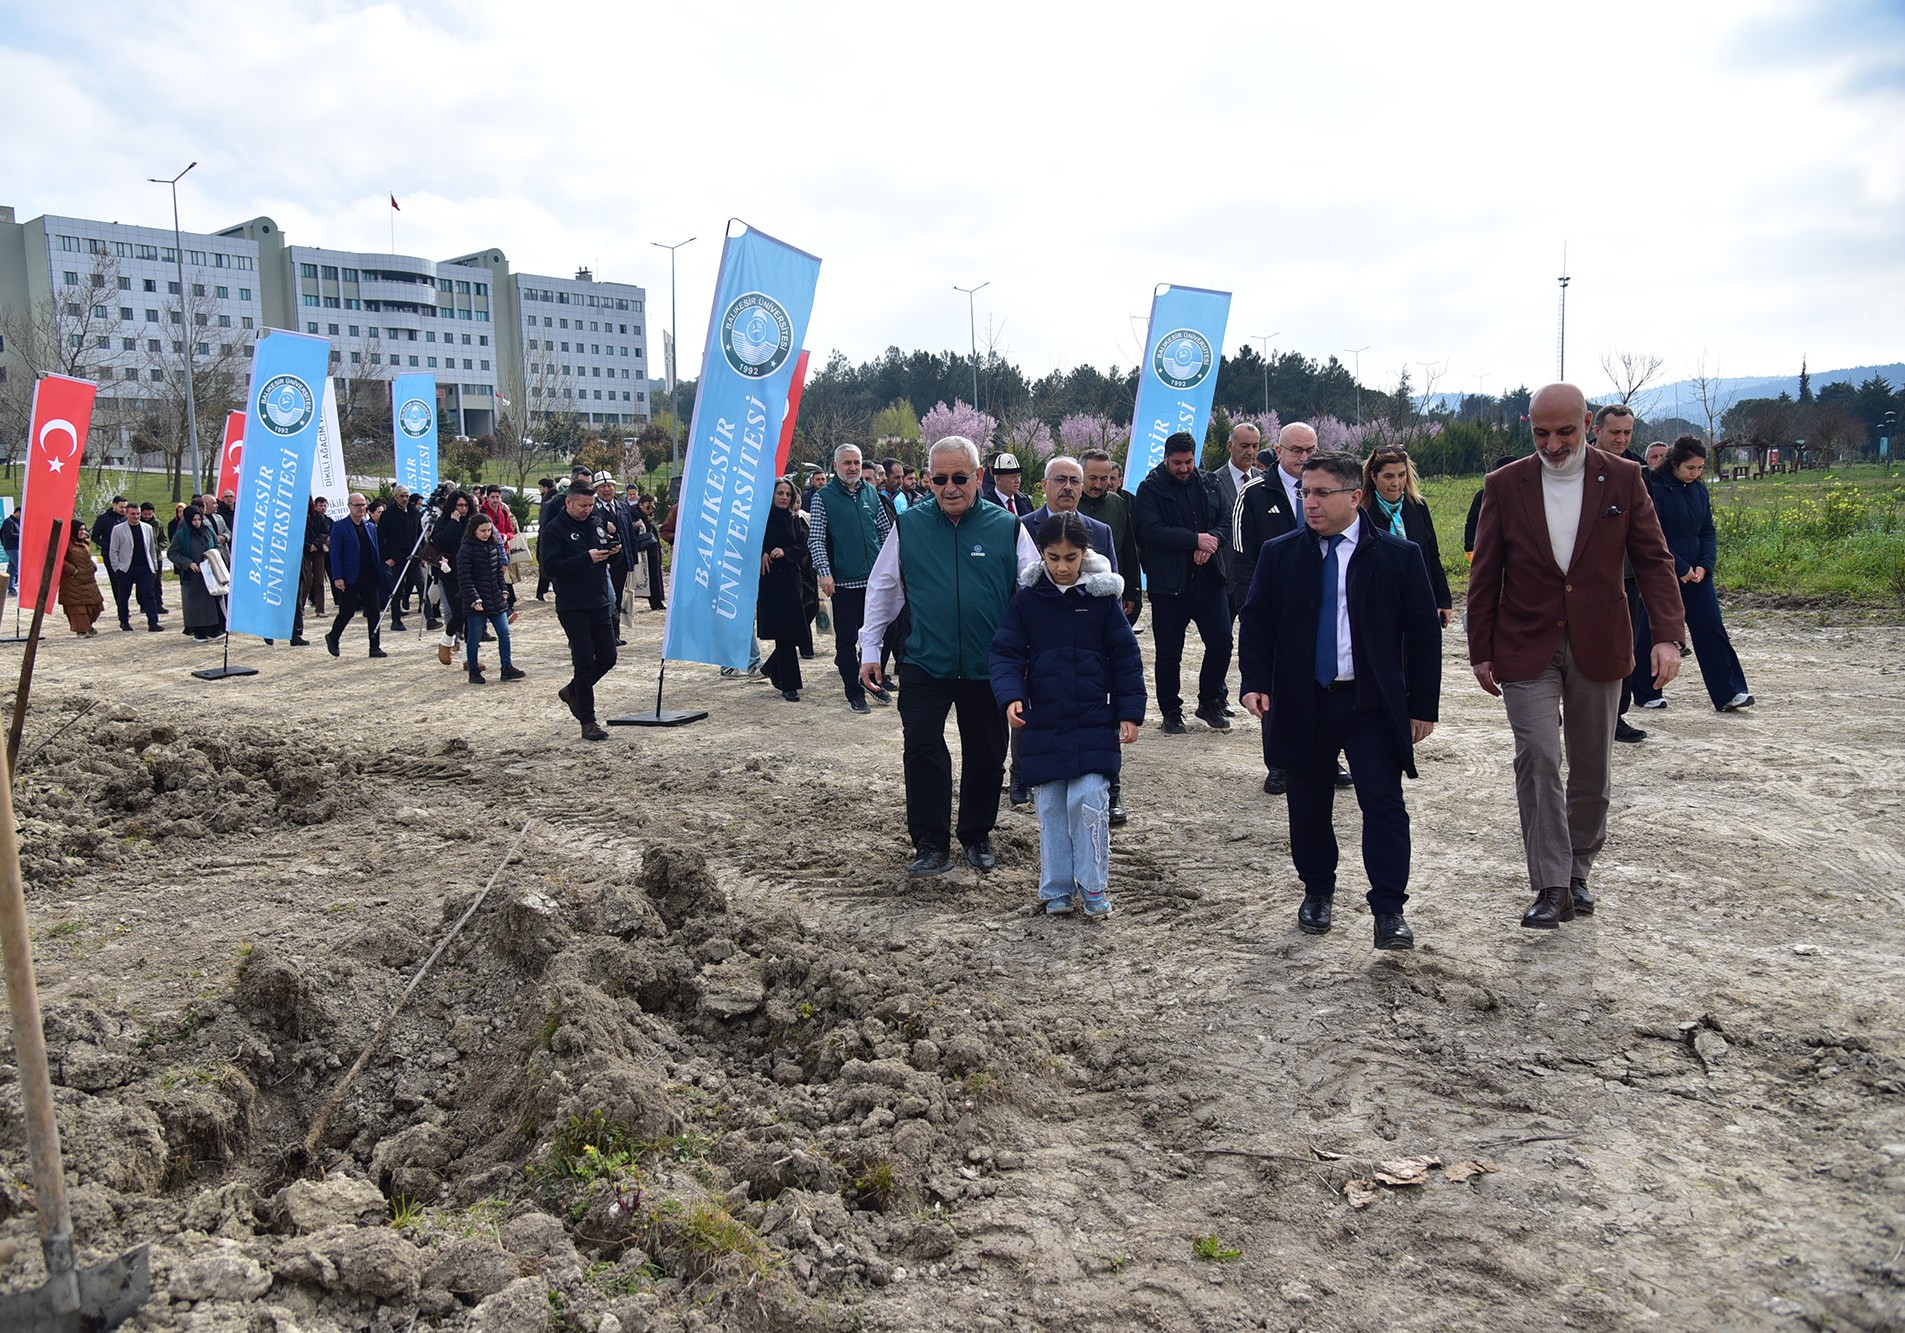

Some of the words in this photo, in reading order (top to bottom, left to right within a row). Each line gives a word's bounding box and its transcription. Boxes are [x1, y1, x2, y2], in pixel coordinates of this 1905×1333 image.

[725, 296, 756, 330] BALIKESİR
[758, 297, 789, 352] ÜNİVERSİTESİ
[1157, 332, 1182, 359] BALIKESİR
[1183, 331, 1210, 366] ÜNİVERSİTESİ
[739, 363, 759, 375] 1992
[1171, 379, 1187, 387] 1992
[260, 378, 285, 404] BALIKESİR
[285, 377, 312, 413] ÜNİVERSİTESİ
[274, 425, 289, 434] 1992
[1146, 418, 1170, 474] ESİR
[404, 457, 418, 493] ESİR
[327, 499, 345, 508] ikili
[694, 416, 736, 590] BALIKESİR
[711, 394, 767, 621] ÜNİVERSİTESİ
[249, 465, 274, 586] BALIKESİR
[263, 447, 299, 607] ÜNİVERSİTESİ
